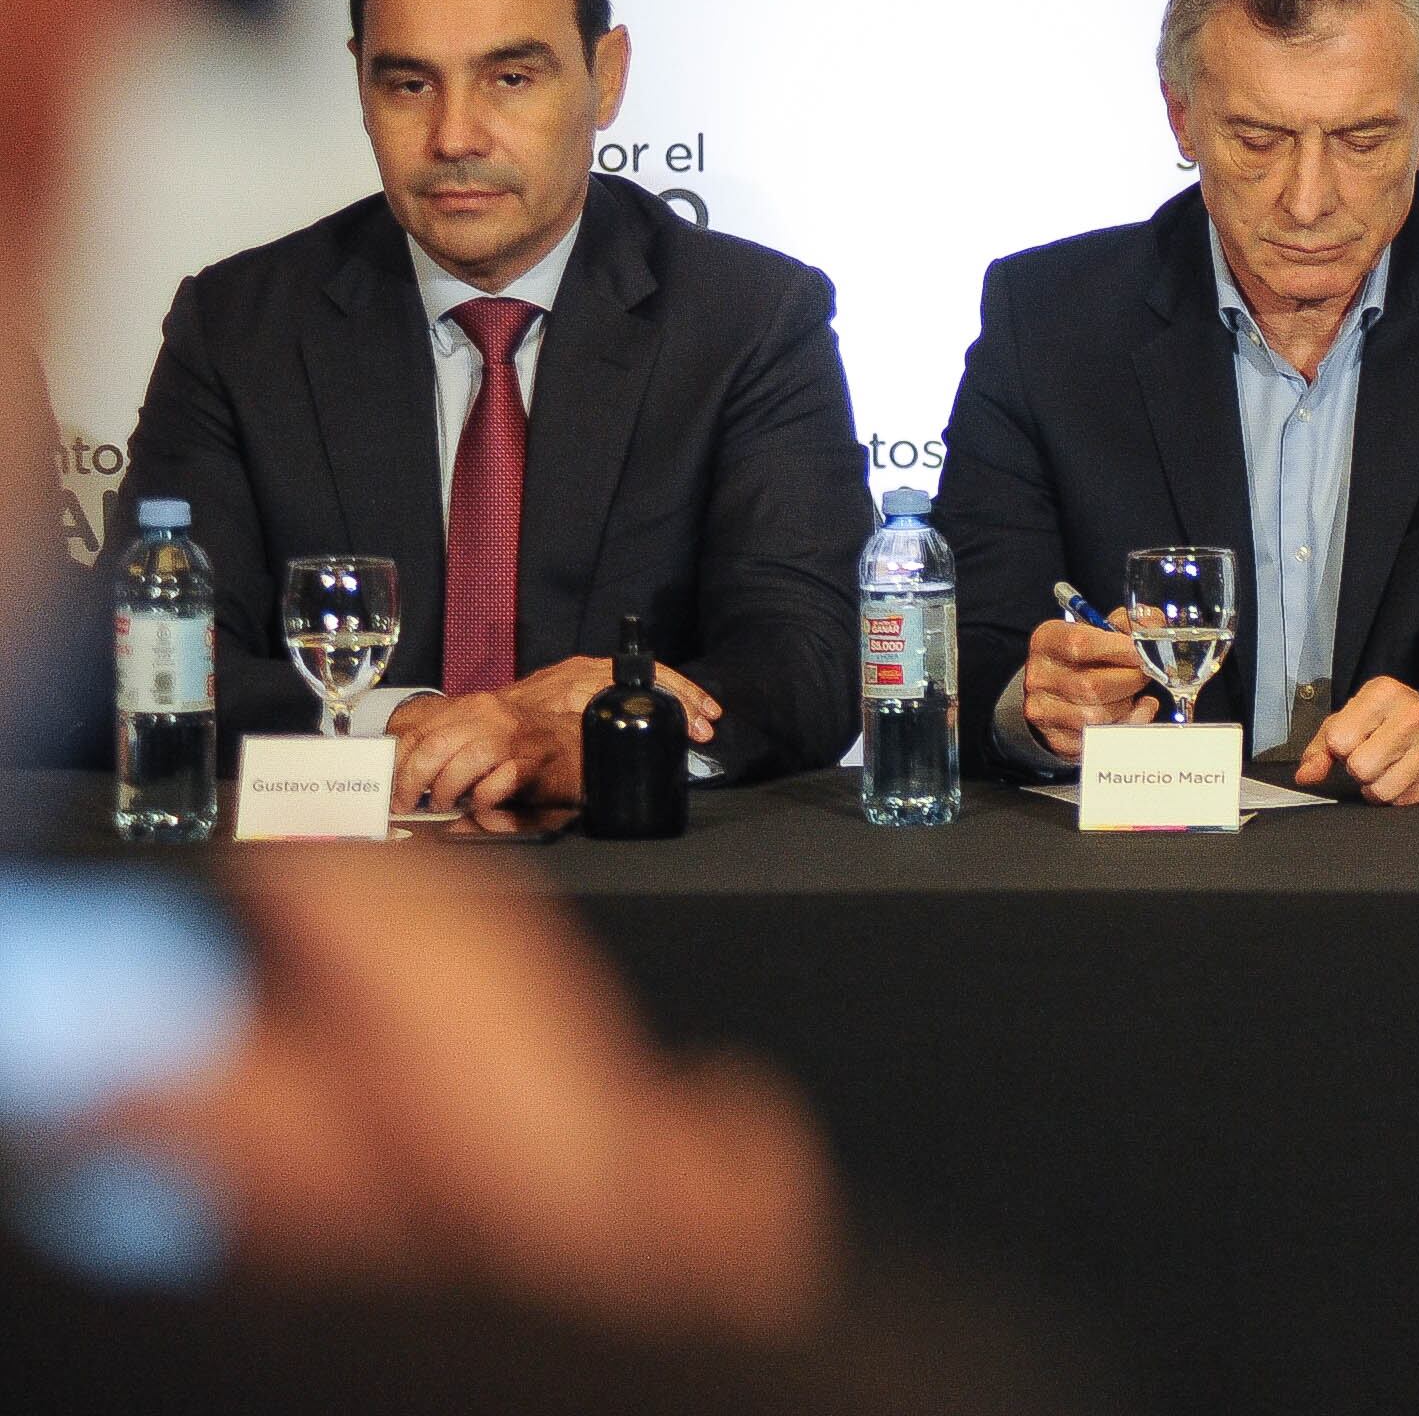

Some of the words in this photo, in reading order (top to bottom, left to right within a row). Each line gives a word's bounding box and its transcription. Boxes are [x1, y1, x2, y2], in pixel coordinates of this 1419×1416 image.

[597, 142, 650, 173] or
[664, 131, 704, 173] el
[868, 432, 944, 470] tos
[252, 779, 320, 793] Gustavo
[326, 777, 381, 793] Valdés
[1097, 770, 1173, 785] Mauricio
[1178, 770, 1226, 785] Macri
